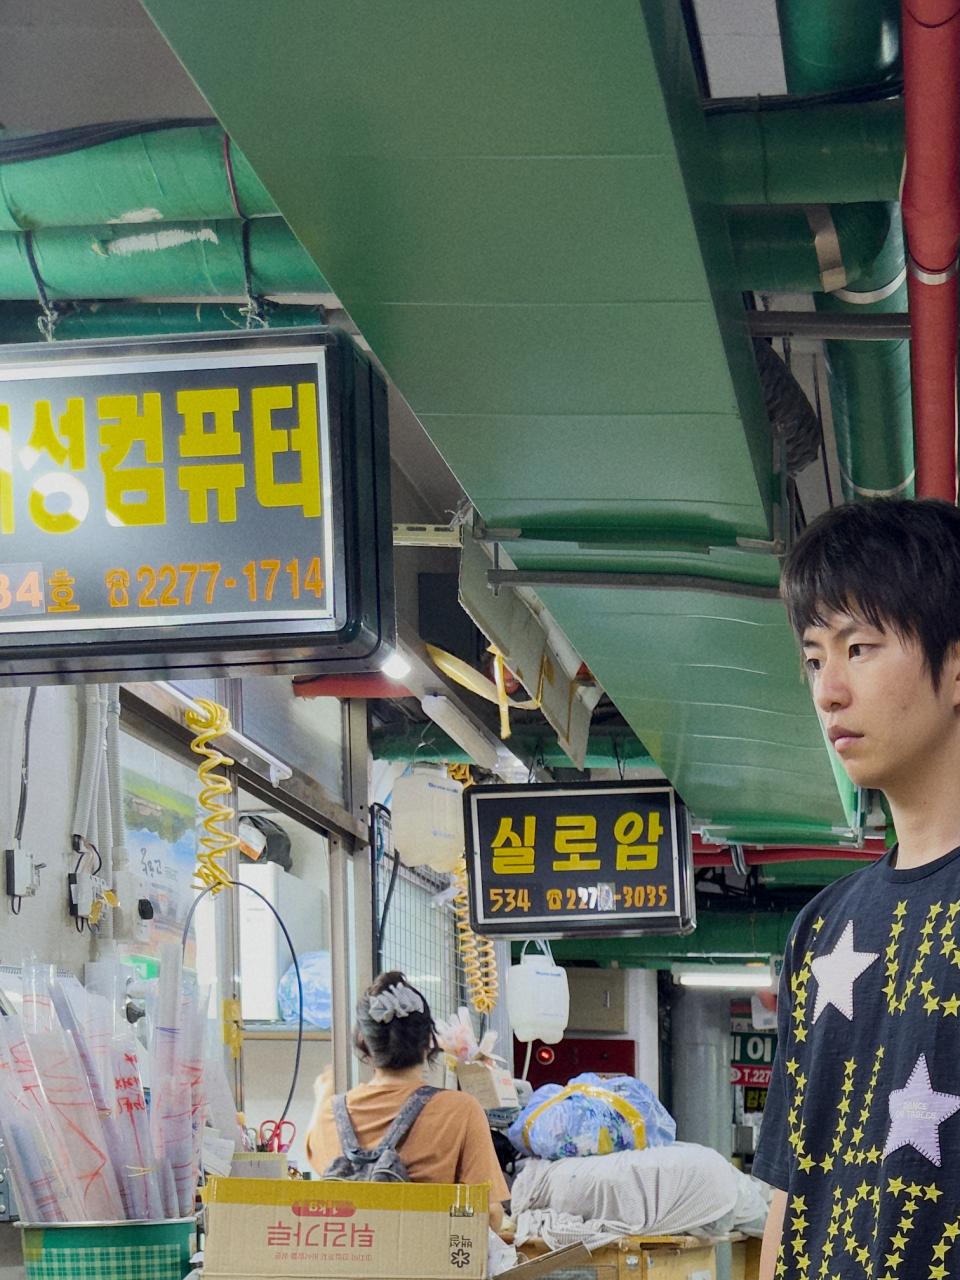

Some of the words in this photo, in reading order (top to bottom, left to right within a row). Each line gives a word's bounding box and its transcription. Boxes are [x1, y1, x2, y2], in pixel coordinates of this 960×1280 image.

[490, 886, 531, 912] 534
[566, 884, 668, 912] 227-3035
[266, 1221, 376, 1248] 튀김가루
